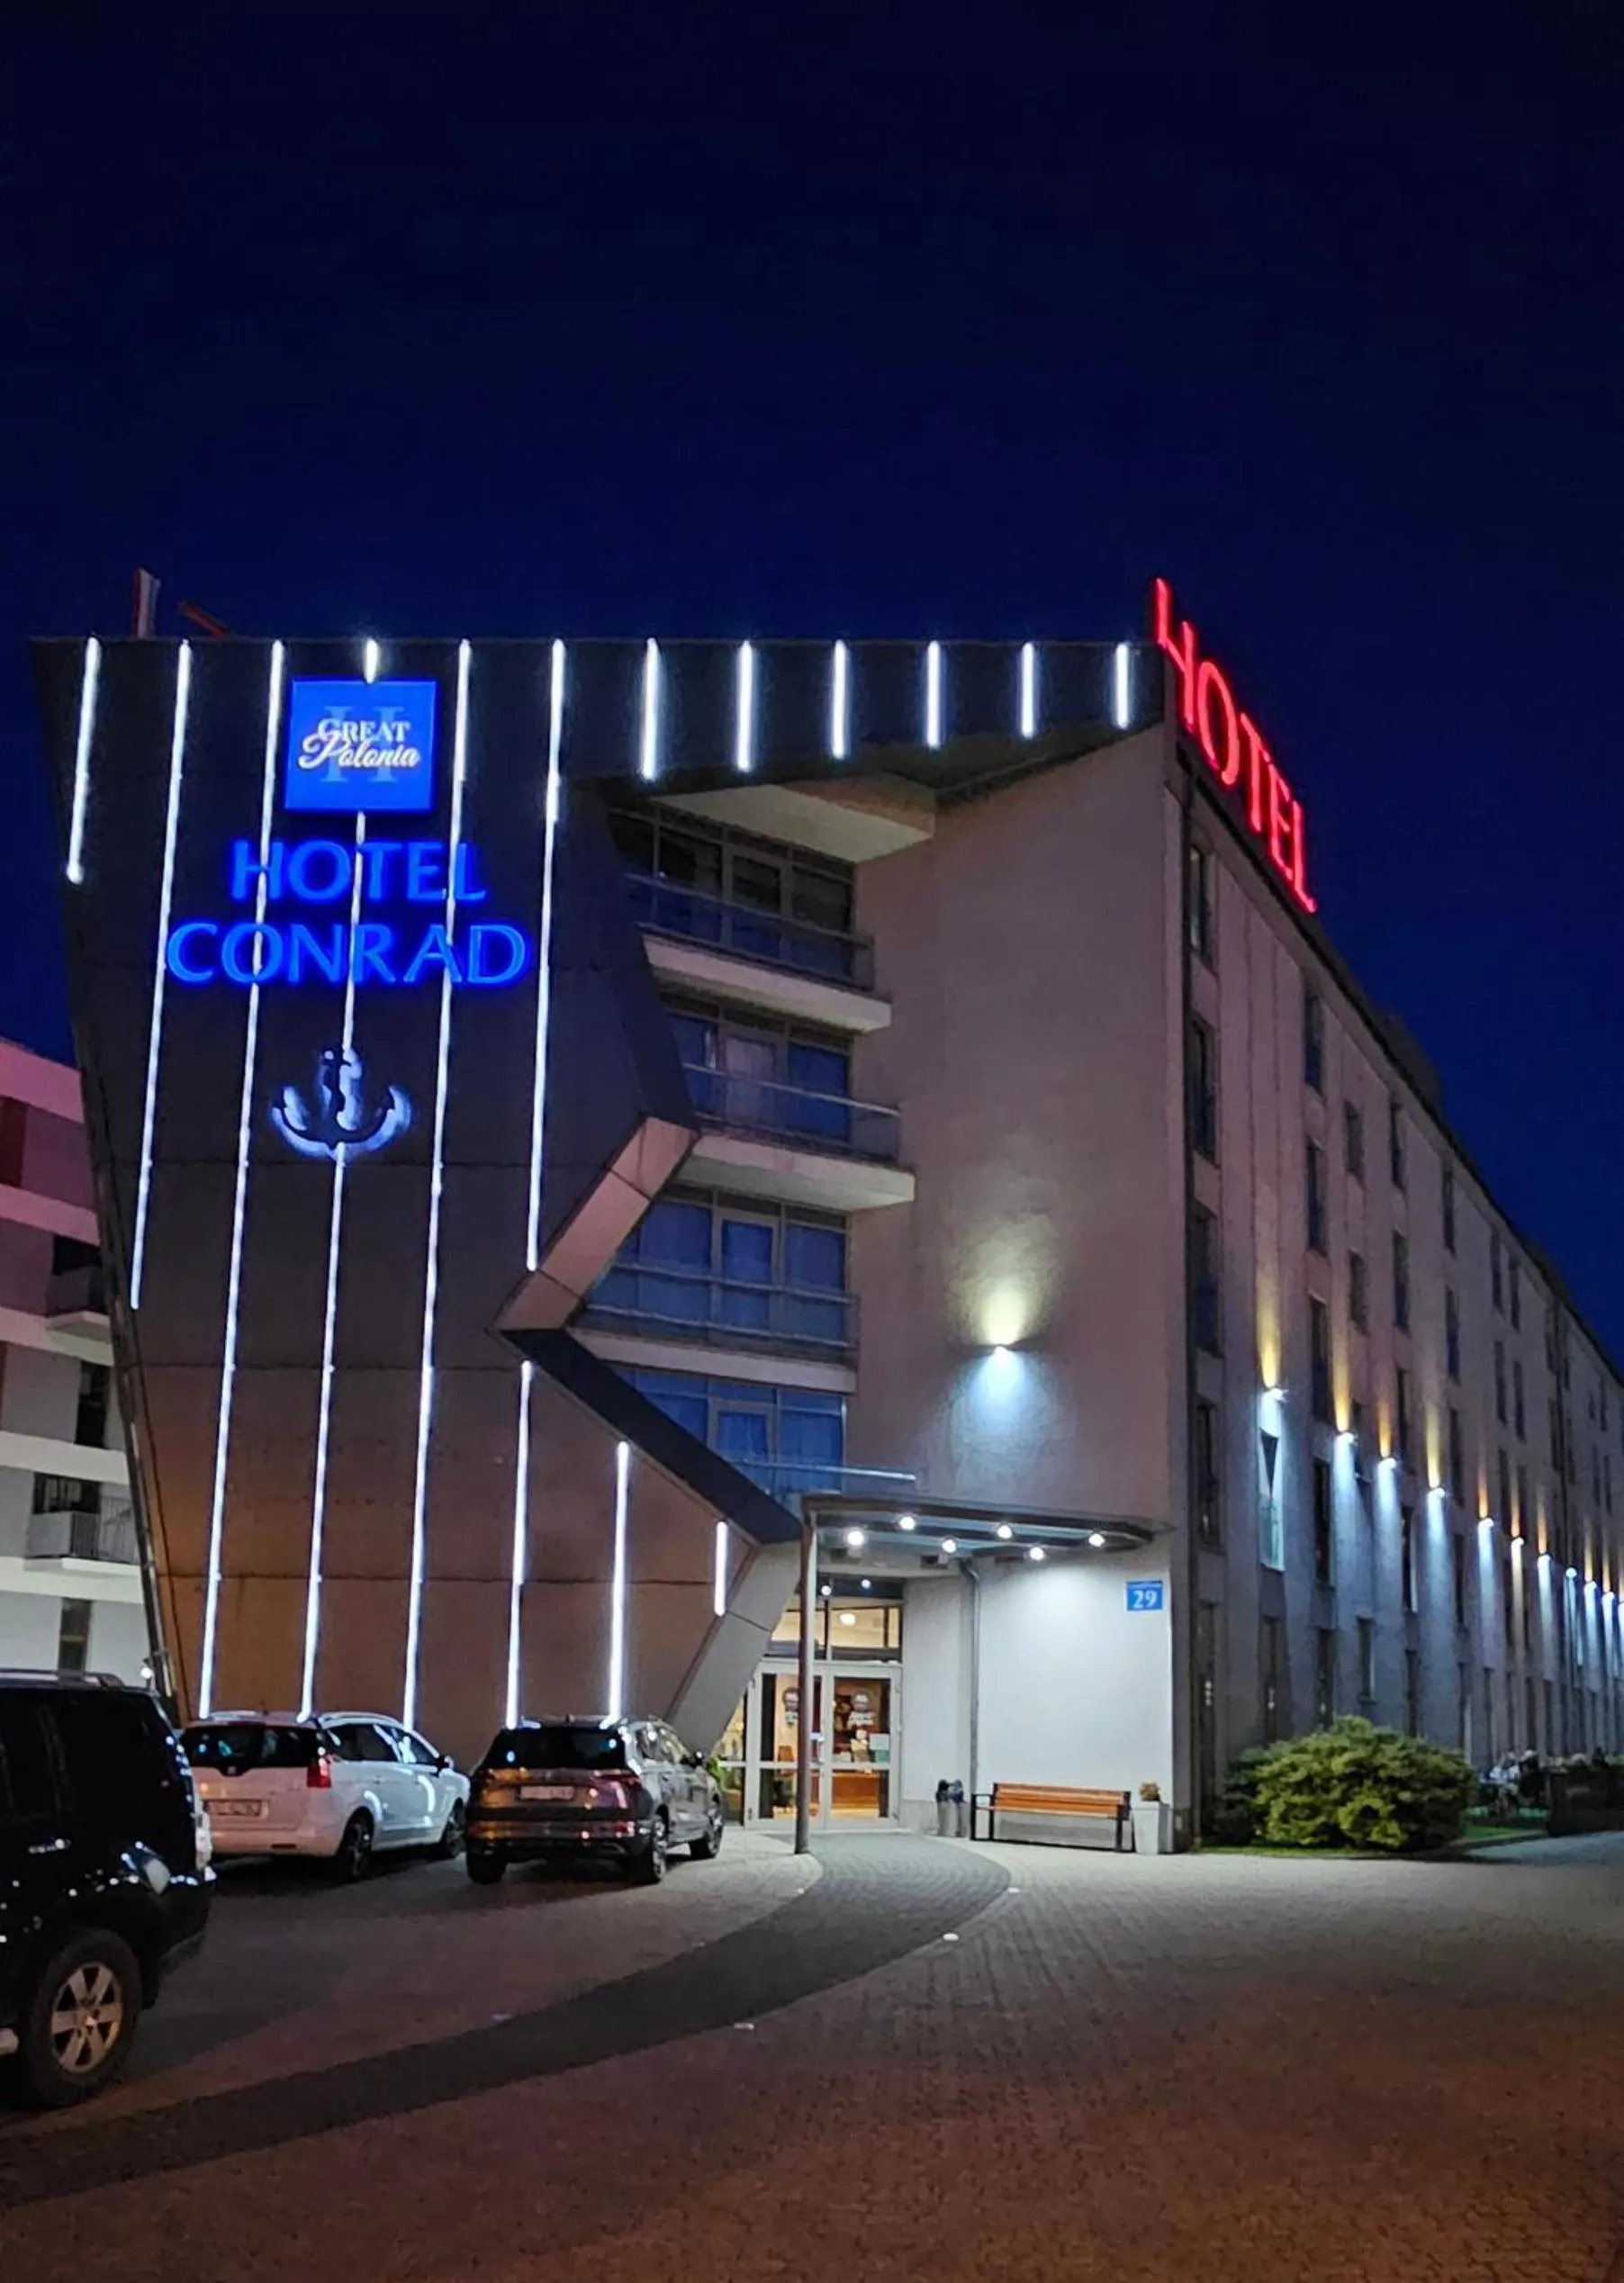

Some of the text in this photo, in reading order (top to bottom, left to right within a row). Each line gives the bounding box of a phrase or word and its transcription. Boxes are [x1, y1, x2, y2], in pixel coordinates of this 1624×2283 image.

[298, 730, 420, 770] Polonia
[317, 718, 411, 743] GREAT
[1157, 578, 1316, 913] HOTEL
[232, 840, 486, 899] HOTEL
[167, 922, 526, 984] CONRAD
[1133, 1590, 1158, 1609] 29
